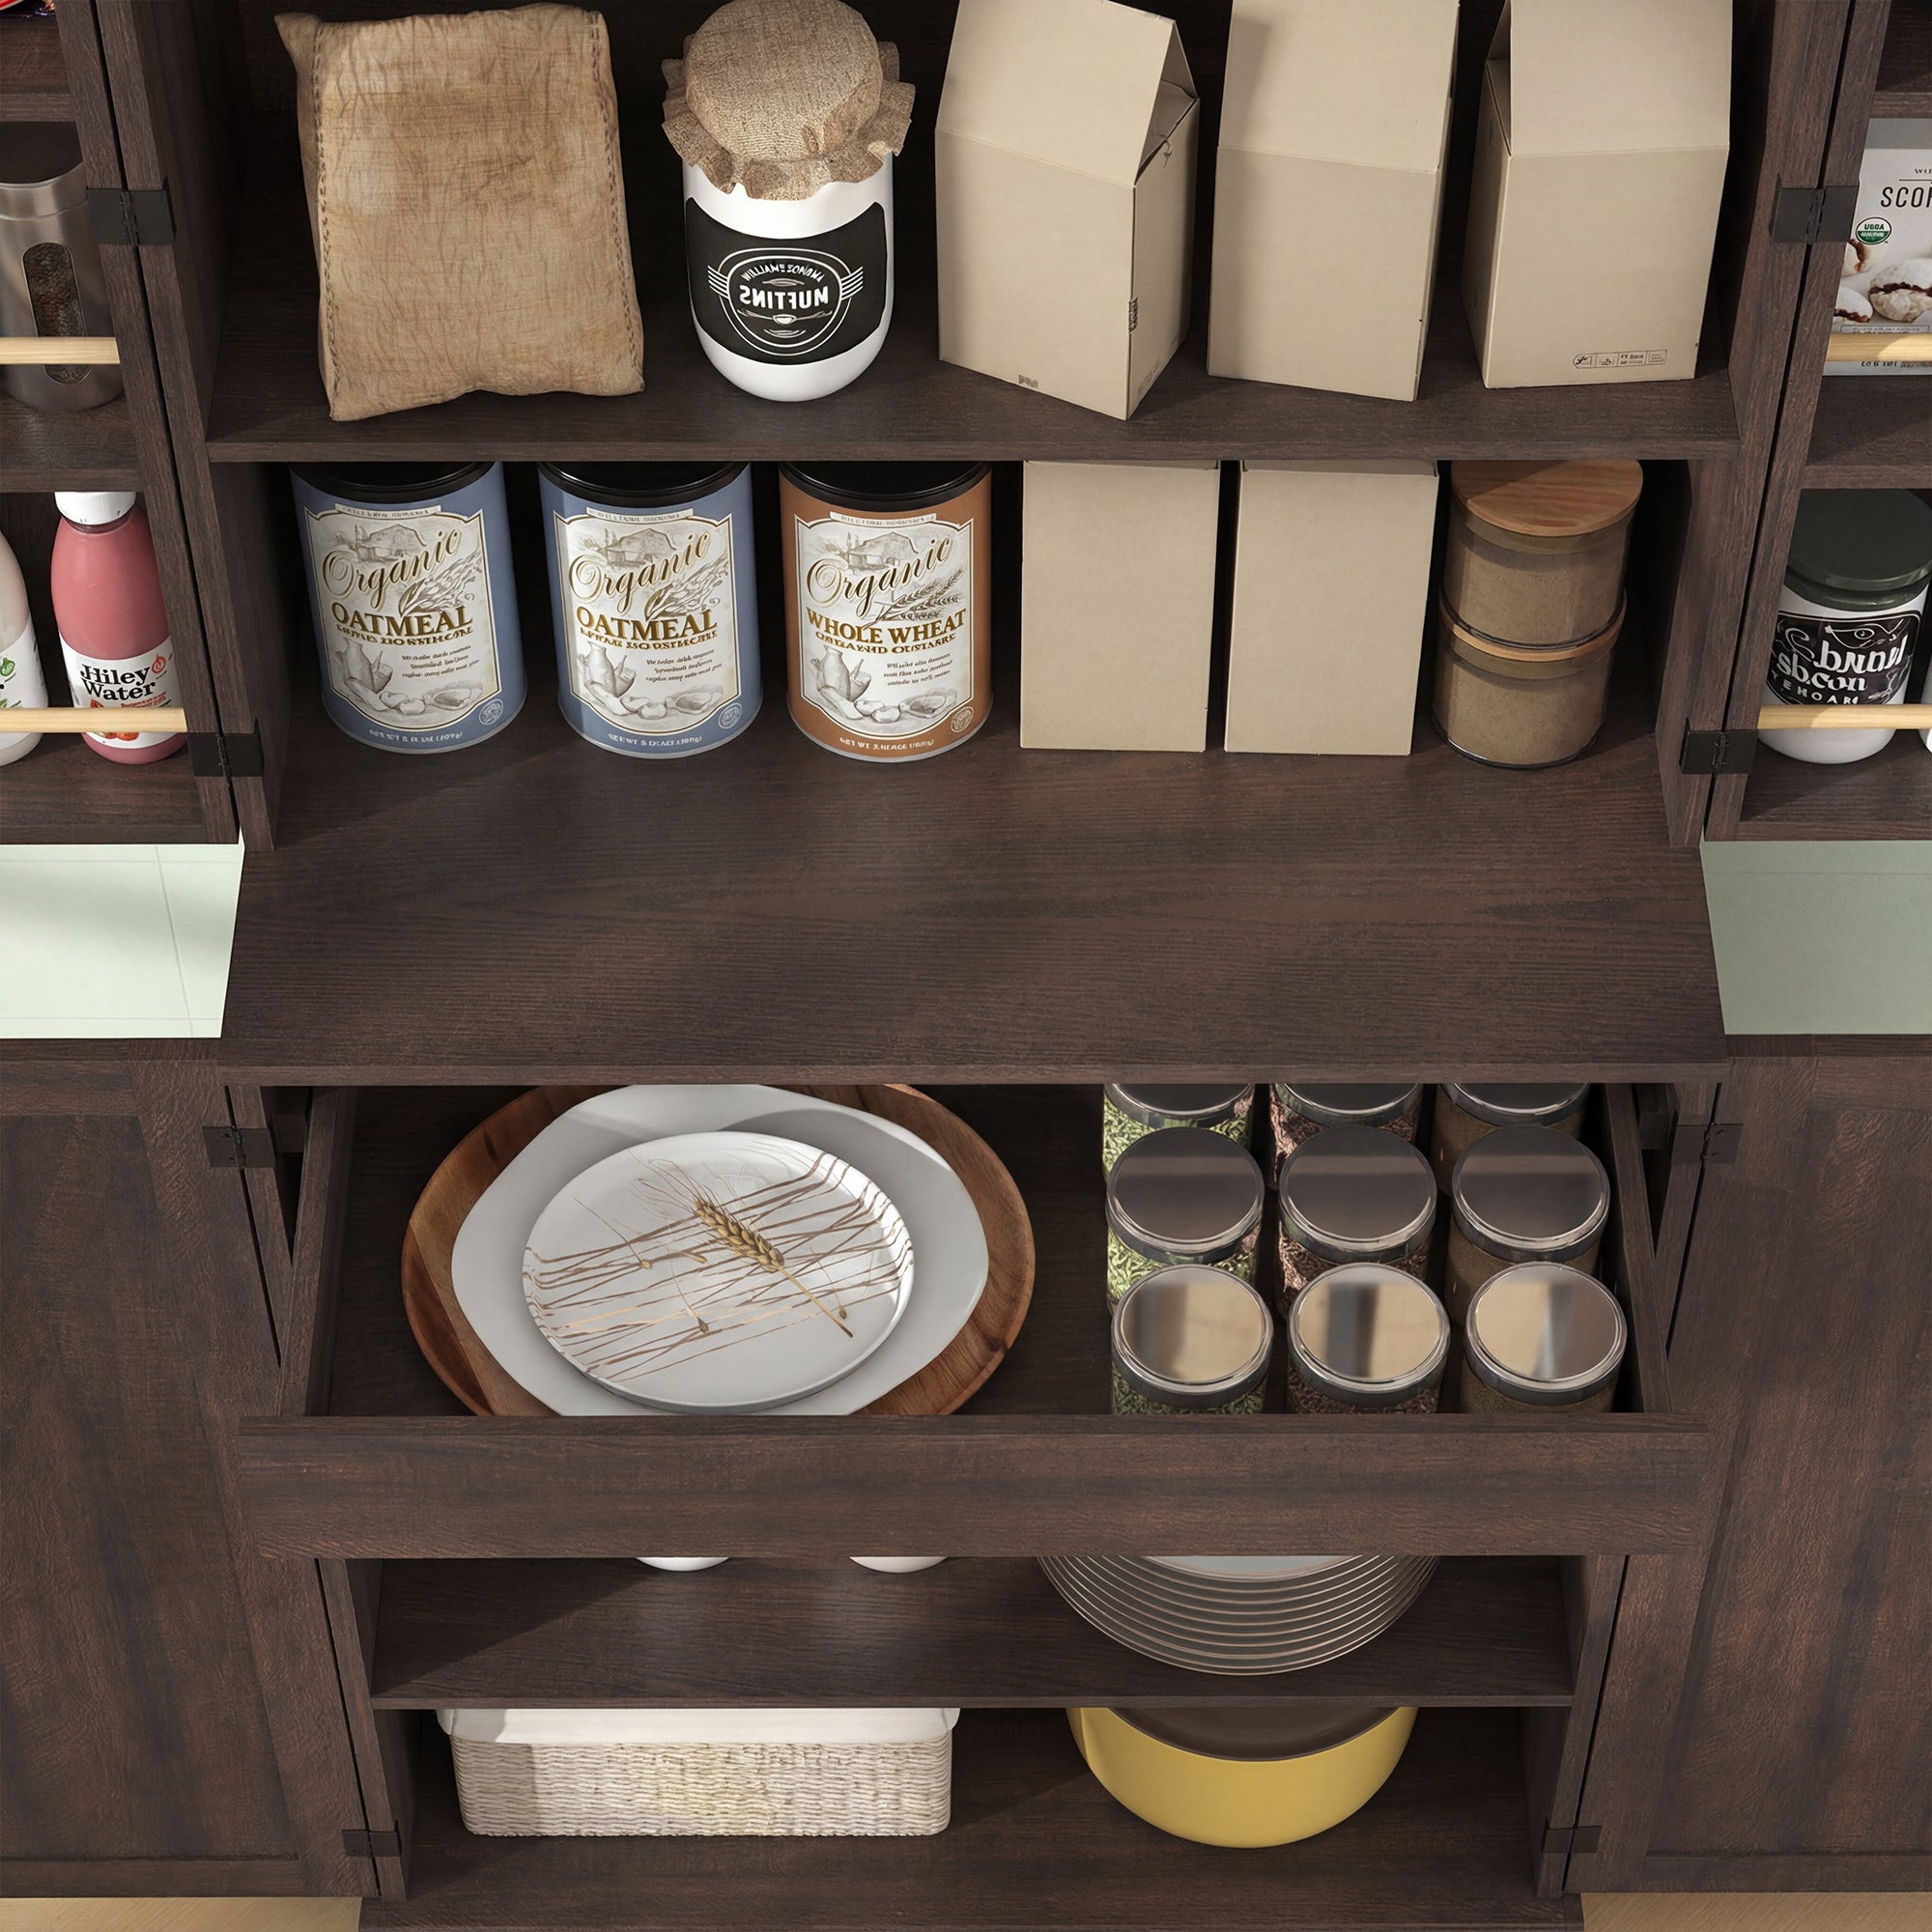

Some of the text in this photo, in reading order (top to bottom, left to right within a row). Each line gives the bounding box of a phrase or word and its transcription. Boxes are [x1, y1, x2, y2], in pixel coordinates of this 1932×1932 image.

[323, 528, 463, 610] Organic
[568, 532, 711, 614] Organic
[807, 535, 952, 619] Organic
[331, 602, 473, 638] OATMEAL
[576, 606, 718, 641] OATMEAL
[807, 607, 884, 644] WHOLE
[887, 608, 967, 644] WHEAT
[80, 664, 151, 686] Hiley
[81, 677, 156, 700] Water
